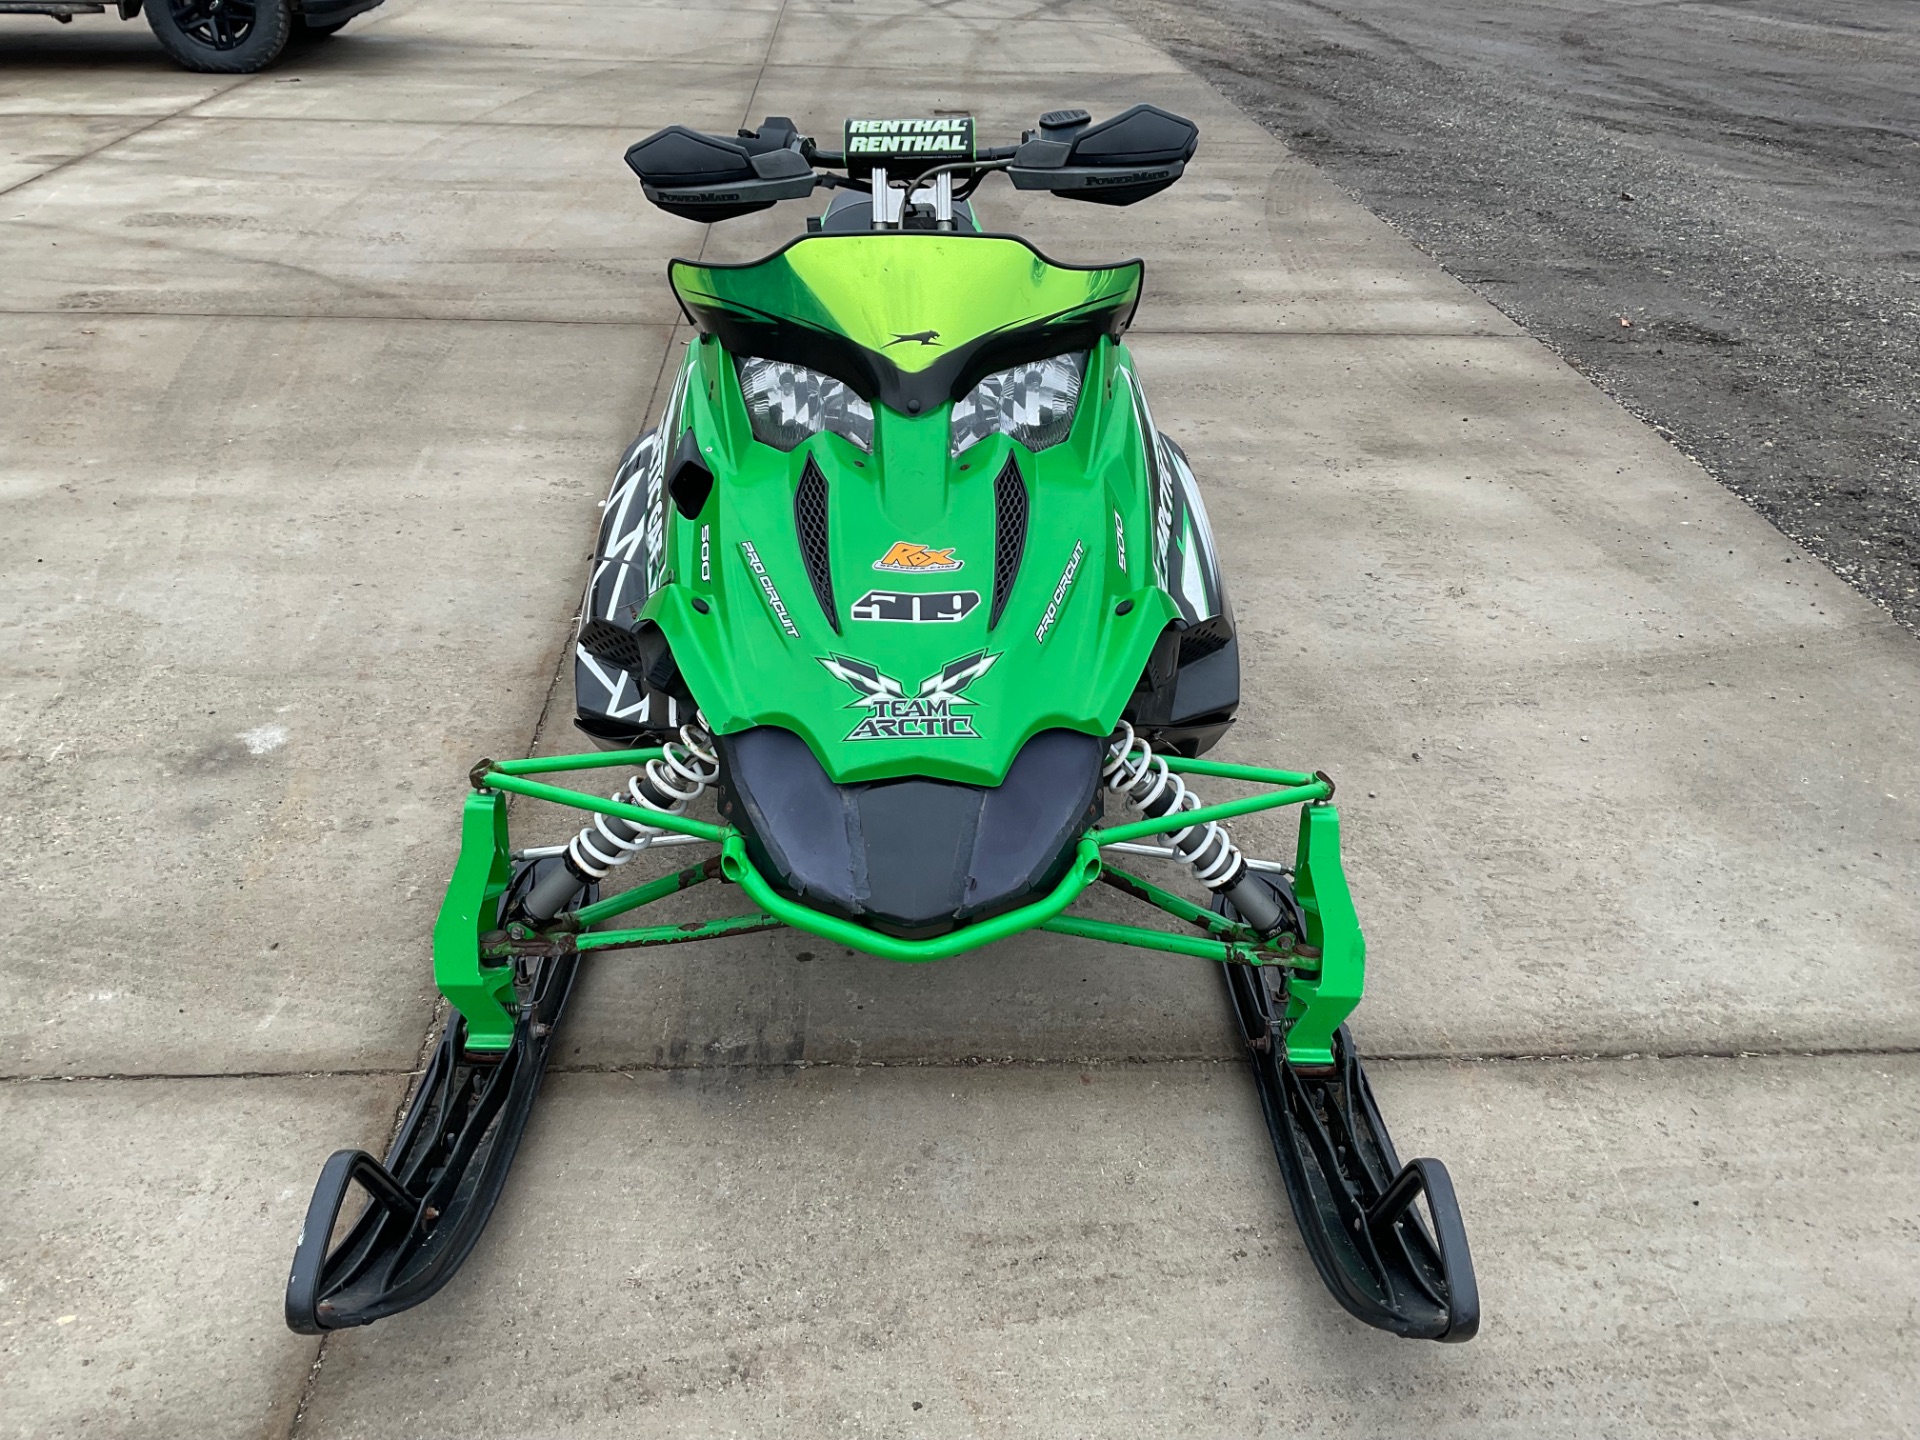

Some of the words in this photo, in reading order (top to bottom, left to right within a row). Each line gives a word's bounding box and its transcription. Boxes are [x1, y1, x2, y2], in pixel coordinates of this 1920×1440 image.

[848, 120, 966, 133] RENTHAL
[848, 134, 967, 152] RENTHAL
[701, 524, 710, 581] 500
[1114, 508, 1127, 574] 500
[742, 541, 766, 574] PRO
[759, 575, 800, 638] CIRCUIT
[1035, 602, 1057, 643] PRO
[1053, 540, 1084, 606] CIRCUIT
[851, 718, 974, 737] ARCTIC
[873, 699, 950, 718] TEAM
